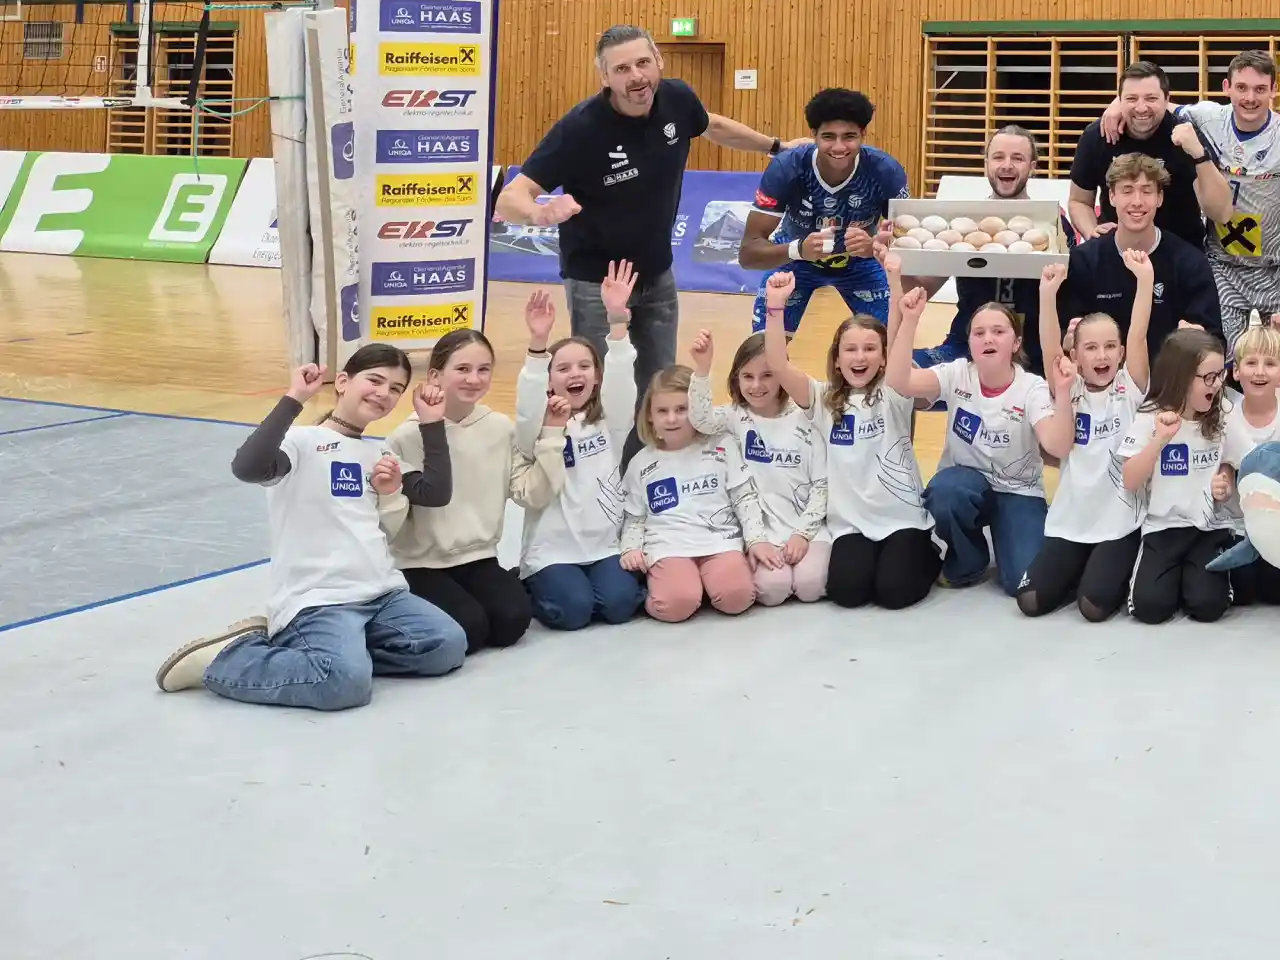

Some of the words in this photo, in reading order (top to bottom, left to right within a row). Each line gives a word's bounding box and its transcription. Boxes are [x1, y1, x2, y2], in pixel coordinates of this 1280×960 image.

[420, 11, 473, 24] HAAS
[385, 52, 459, 65] Raiffeisen
[417, 140, 470, 153] HAAS
[616, 168, 639, 180] HAAS
[382, 183, 456, 196] Raiffeisen
[413, 271, 466, 284] HAAS
[377, 316, 451, 329] Raiffeisen
[578, 435, 607, 454] HAS
[1192, 450, 1219, 464] HAAS
[1162, 462, 1188, 471] UNIQA
[331, 483, 361, 491] UNIQA
[681, 478, 719, 494] HAAS
[650, 497, 676, 509] UNIQA
